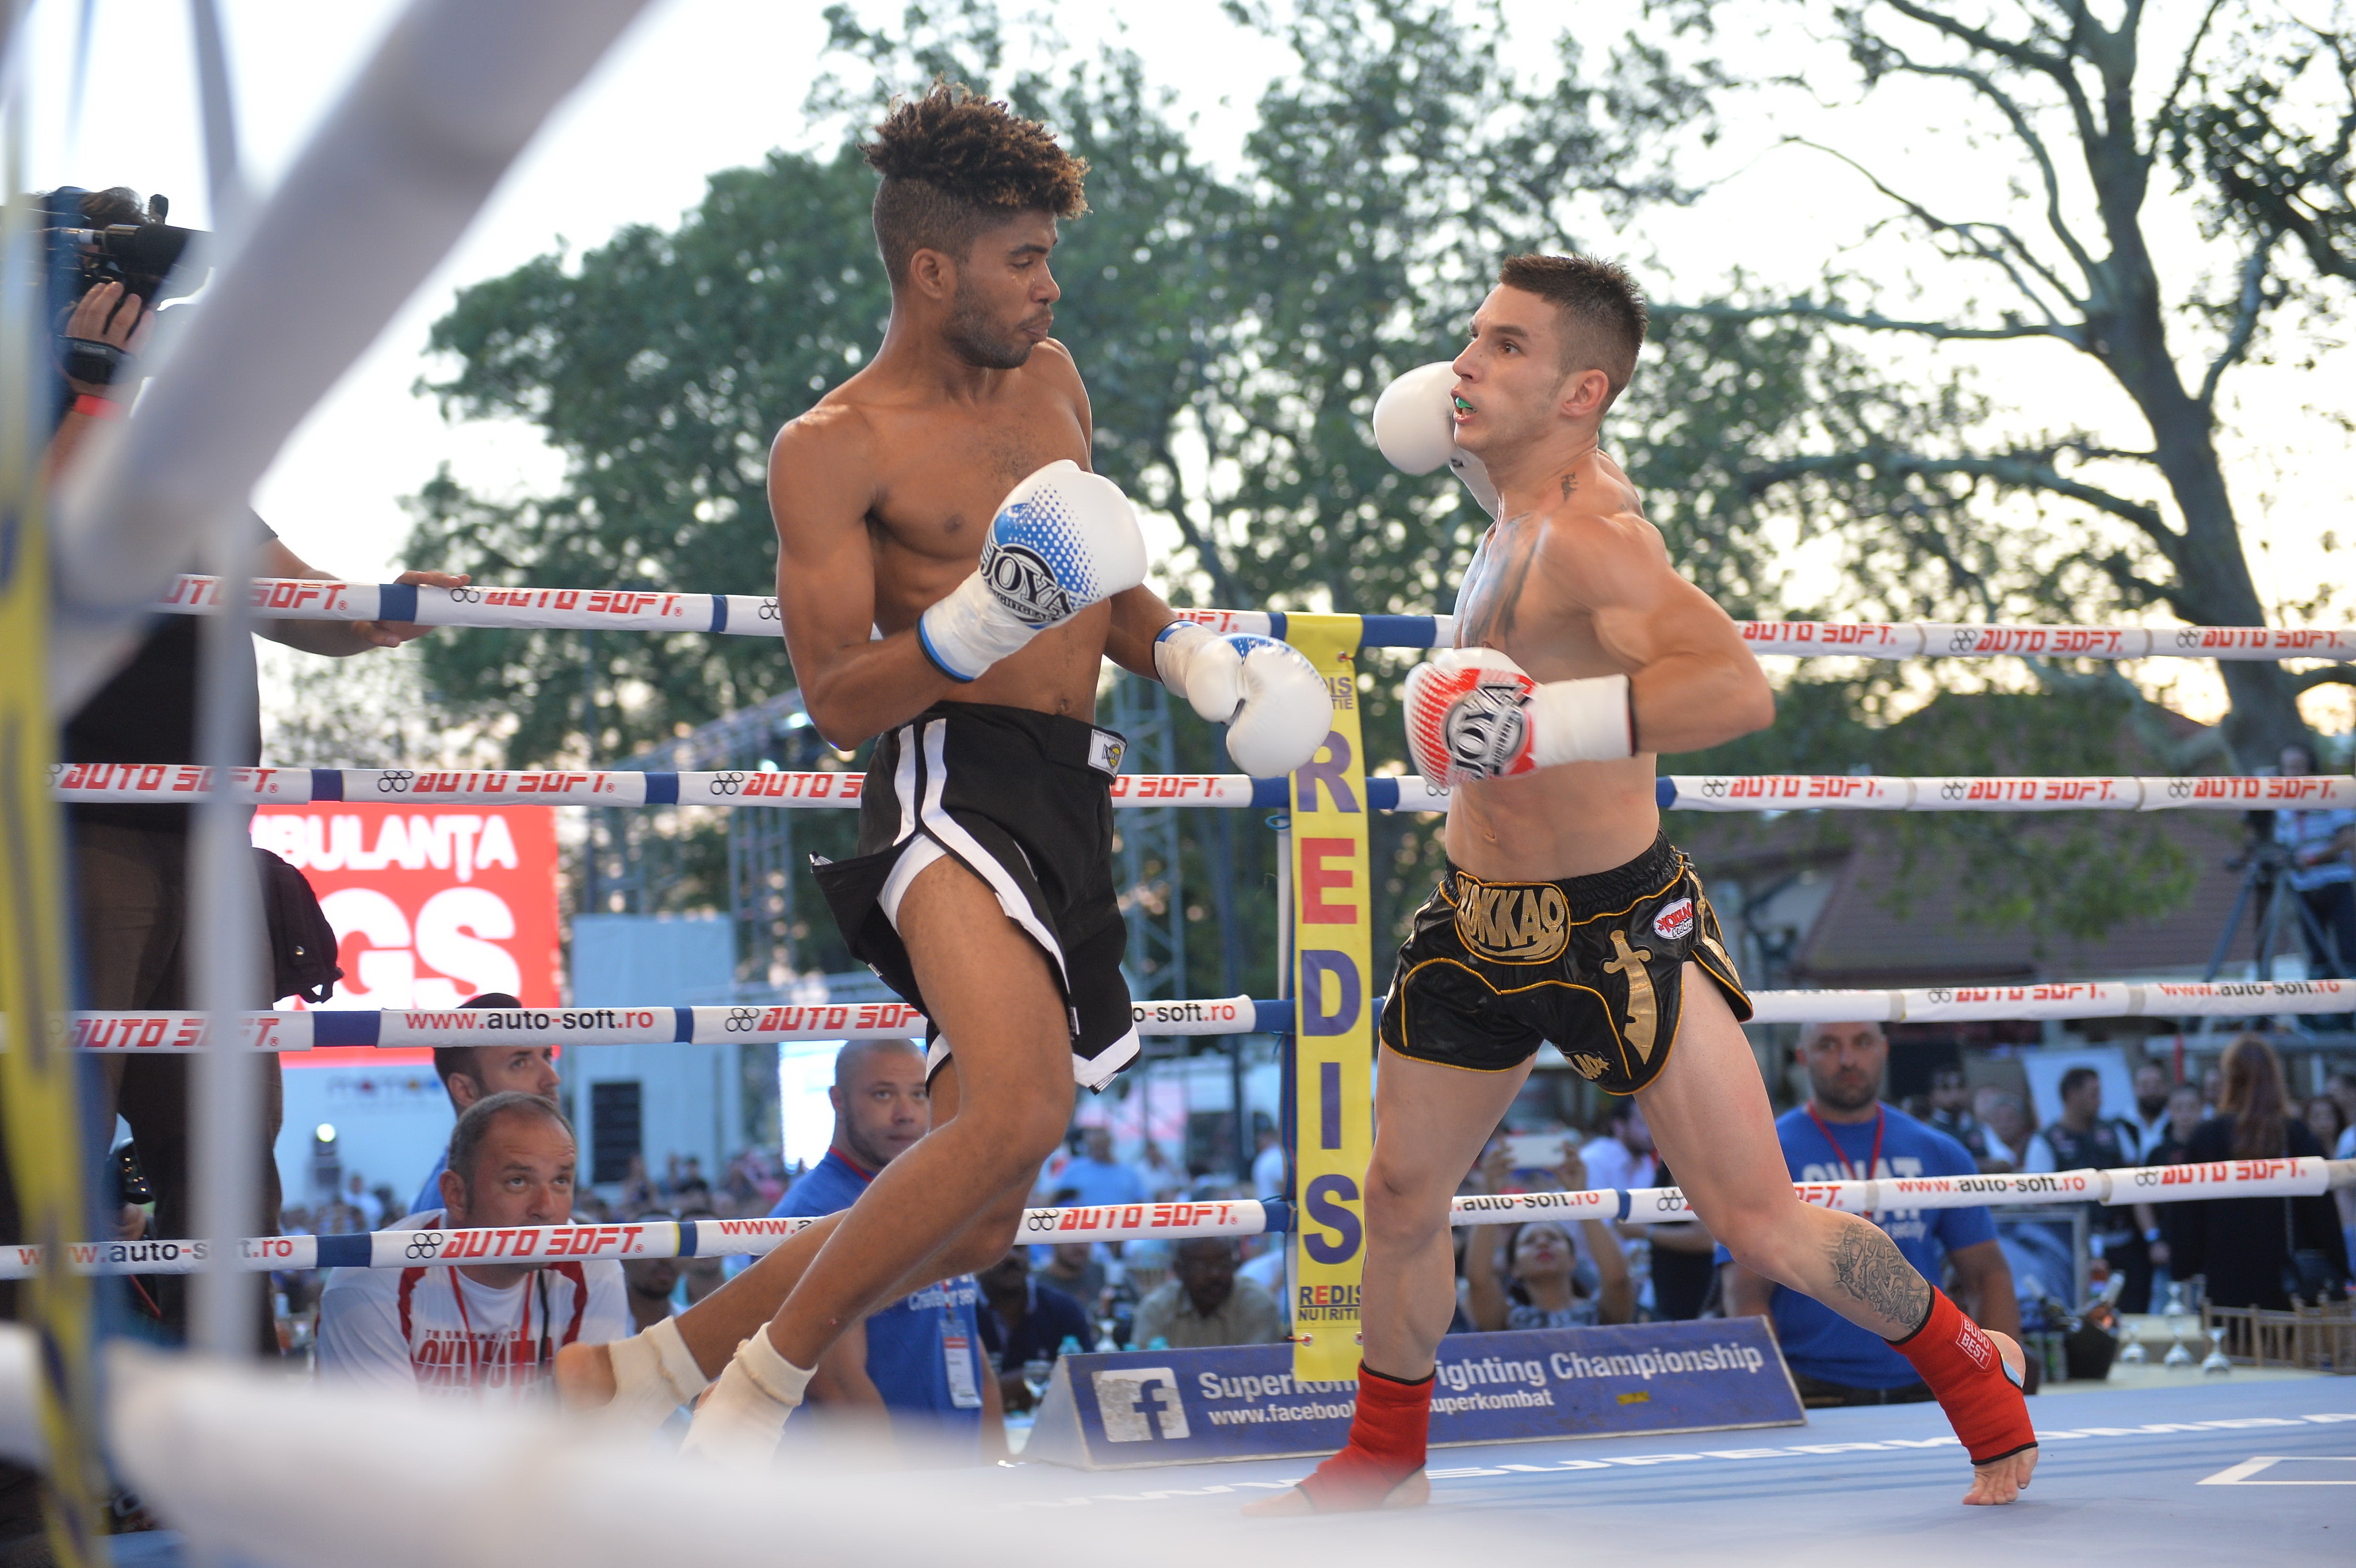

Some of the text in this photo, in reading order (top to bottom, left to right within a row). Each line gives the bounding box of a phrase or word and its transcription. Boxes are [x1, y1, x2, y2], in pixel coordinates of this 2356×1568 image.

[981, 542, 1076, 617] JOYA
[485, 588, 680, 616] AUTO SOFT
[994, 591, 1053, 621] IGHTGEAR
[1743, 621, 1892, 645] AUTO SOFT
[1974, 629, 2122, 653] AUTO SOFT
[2202, 630, 2339, 648] AUTO SOFT
[60, 763, 166, 791] AUTO
[412, 772, 611, 793] AUTO SOFT
[742, 773, 834, 798] AUTO
[1137, 777, 1220, 797] SOFT
[1729, 776, 1880, 797] AUTO SOFT
[2193, 779, 2334, 800] AUTO SOFT
[1967, 779, 2113, 802] AUTO SOFT
[1297, 730, 1362, 1264] REDIS
[1955, 982, 2096, 1003] AUTO SOFT
[404, 1010, 654, 1030] www.auto-soft.ro
[757, 1004, 921, 1032] AUTO SOF
[64, 1019, 168, 1047] AUTO
[1895, 1174, 2086, 1194] www.auto-soft.ro
[2161, 1158, 2298, 1185] AUTO SOFT
[1058, 1203, 1234, 1230] AUTO SOFT
[440, 1226, 643, 1258] AUTO SOFT
[1298, 1306, 1361, 1321] NUTRITI
[1963, 1318, 1989, 1350] BUDO
[1961, 1332, 1987, 1363] BEST
[1435, 1356, 1547, 1392] ighting
[1550, 1340, 1764, 1381] Championship
